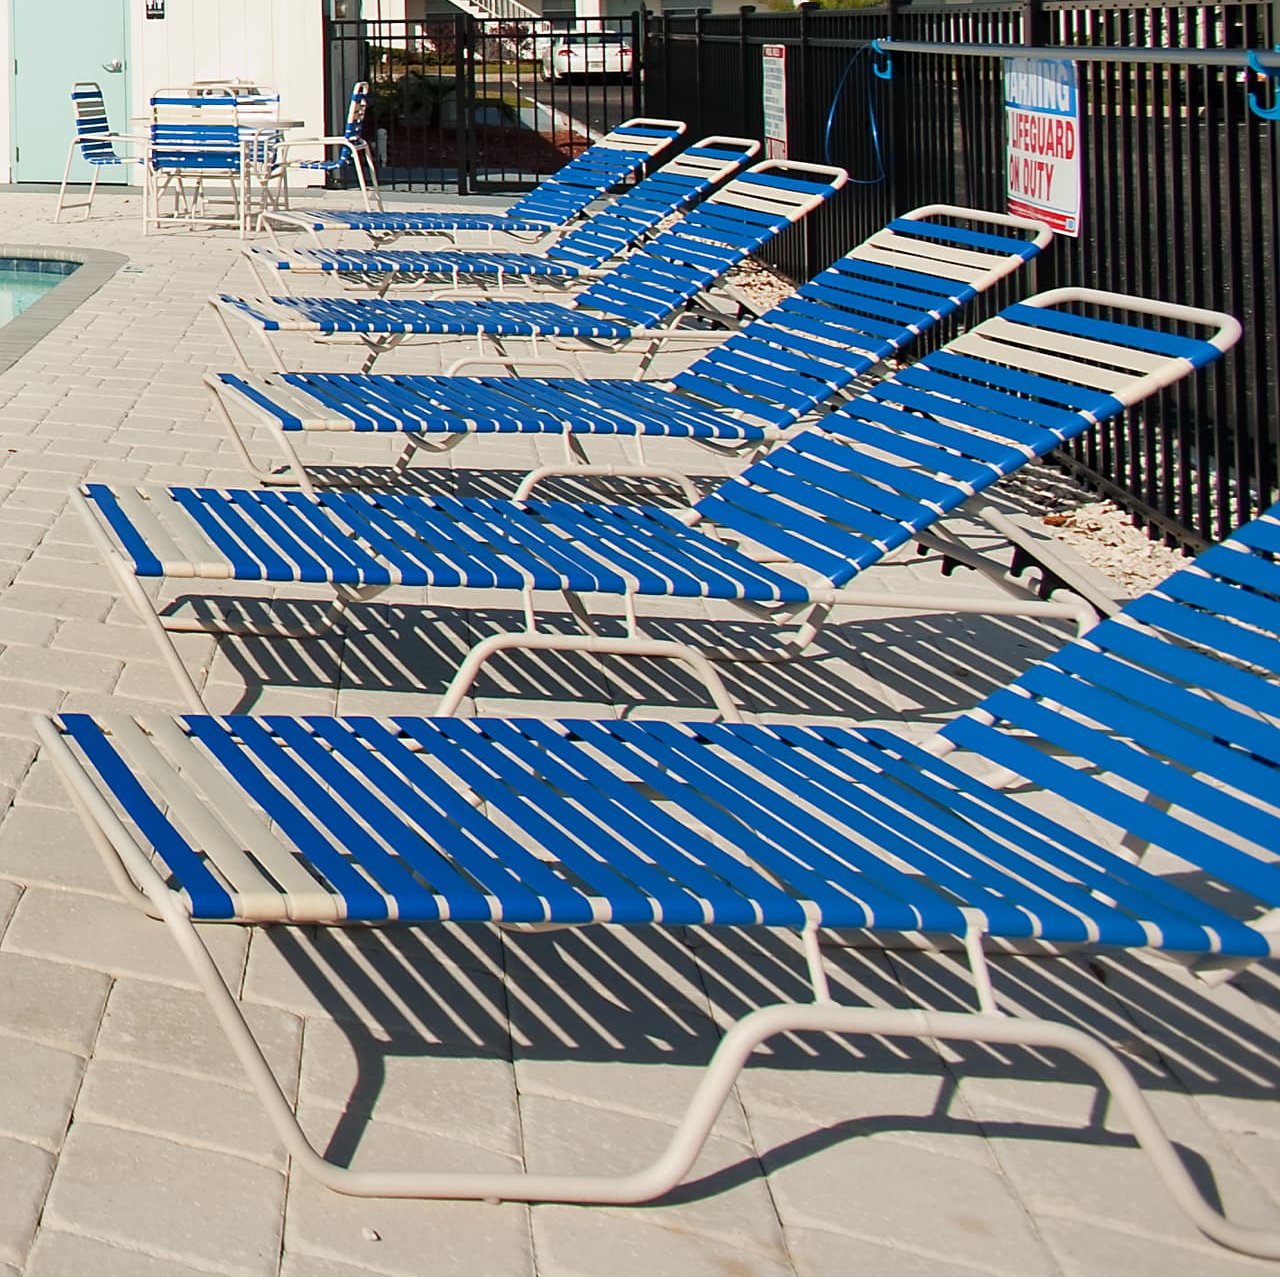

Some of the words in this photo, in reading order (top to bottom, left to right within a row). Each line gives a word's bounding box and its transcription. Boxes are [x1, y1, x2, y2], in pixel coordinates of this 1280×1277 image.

[1011, 111, 1075, 160] LIFEGUARD
[1009, 153, 1020, 193] ON
[1023, 158, 1055, 201] DUTY
